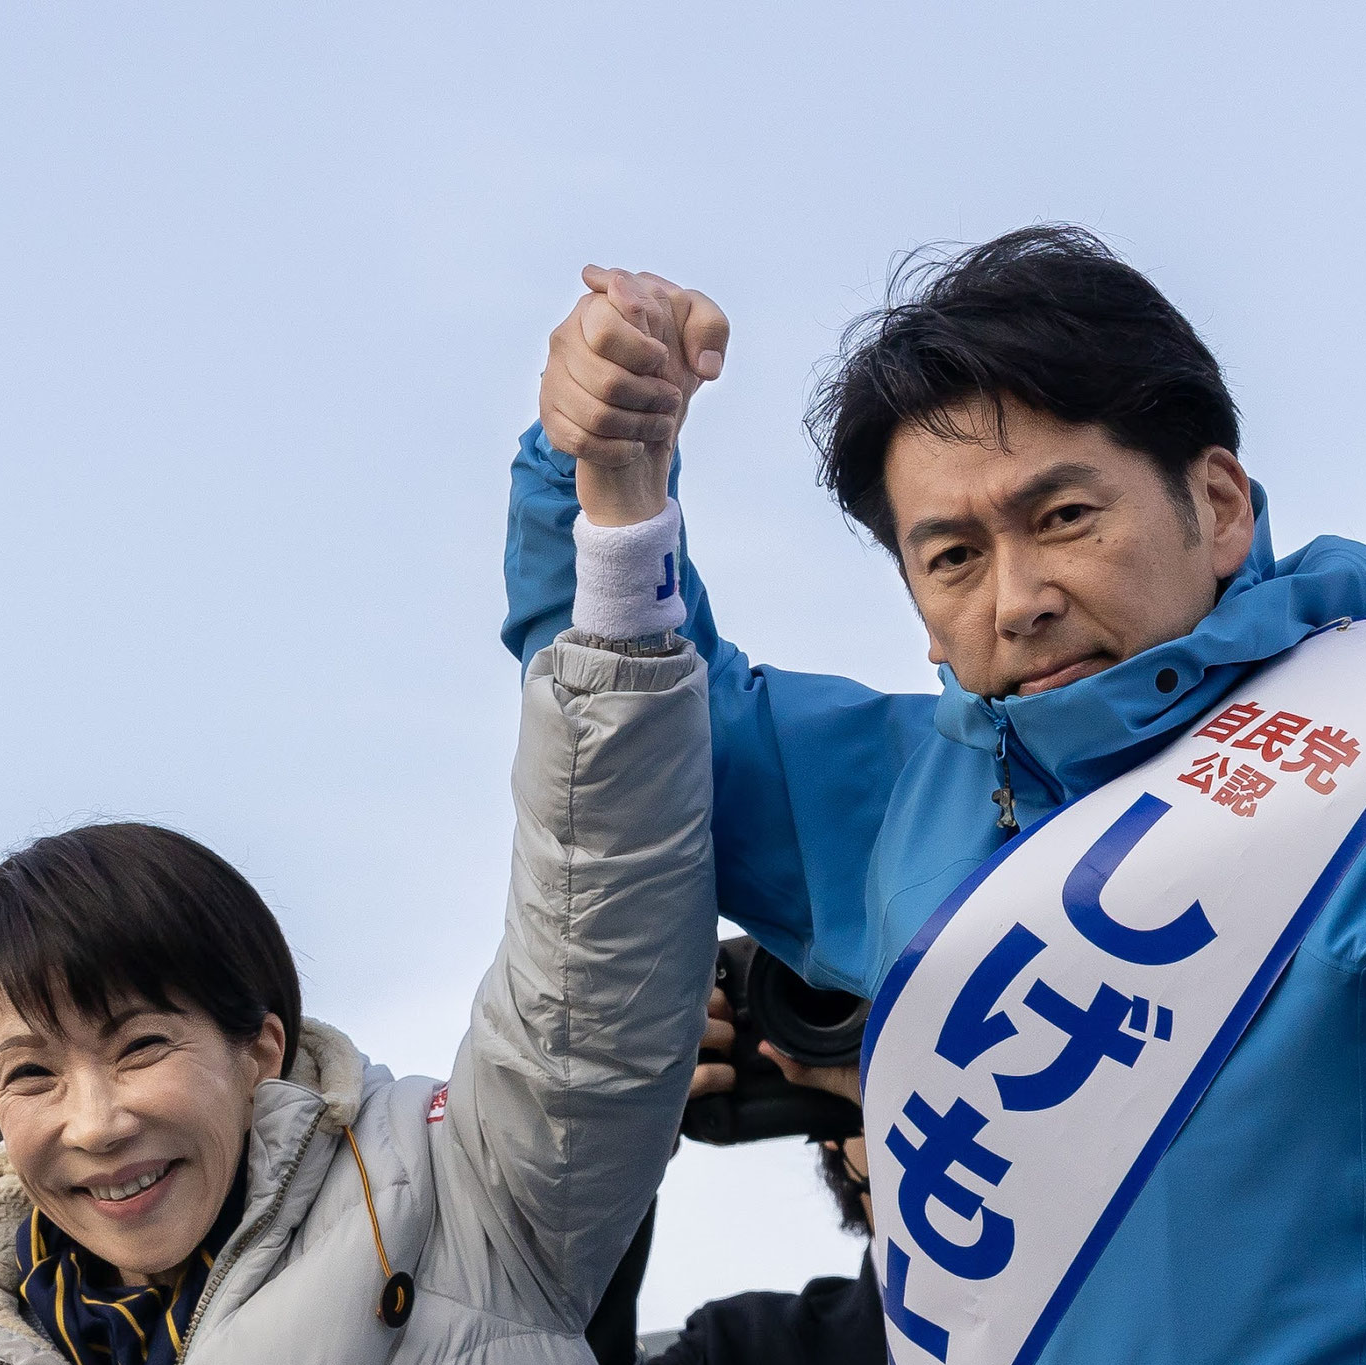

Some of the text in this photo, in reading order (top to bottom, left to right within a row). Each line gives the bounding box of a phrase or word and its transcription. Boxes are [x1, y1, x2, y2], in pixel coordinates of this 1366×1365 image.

[1177, 752, 1277, 817] 公認
[1192, 701, 1362, 795] 自民党
